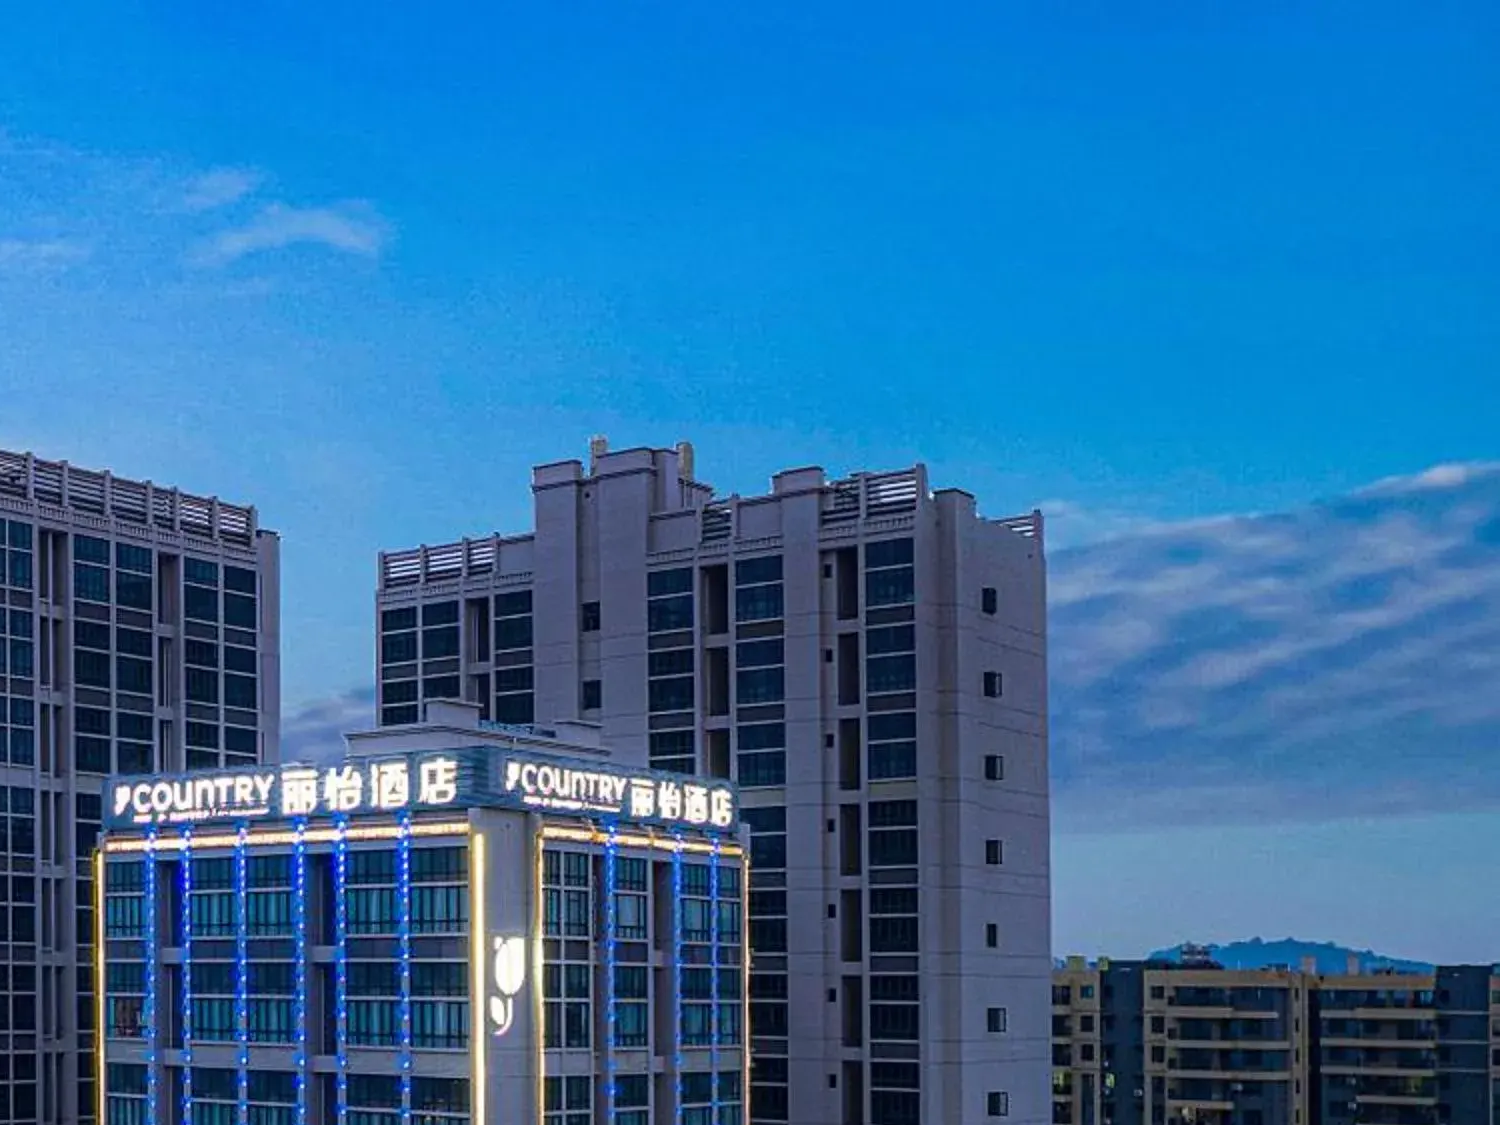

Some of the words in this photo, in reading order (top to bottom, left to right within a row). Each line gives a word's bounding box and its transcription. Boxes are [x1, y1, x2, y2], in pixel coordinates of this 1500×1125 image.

[133, 774, 274, 813] COUNTRY
[281, 759, 458, 814] 丽怡酒店
[521, 764, 627, 800] COUNTRY
[631, 779, 732, 827] 丽怡酒店
